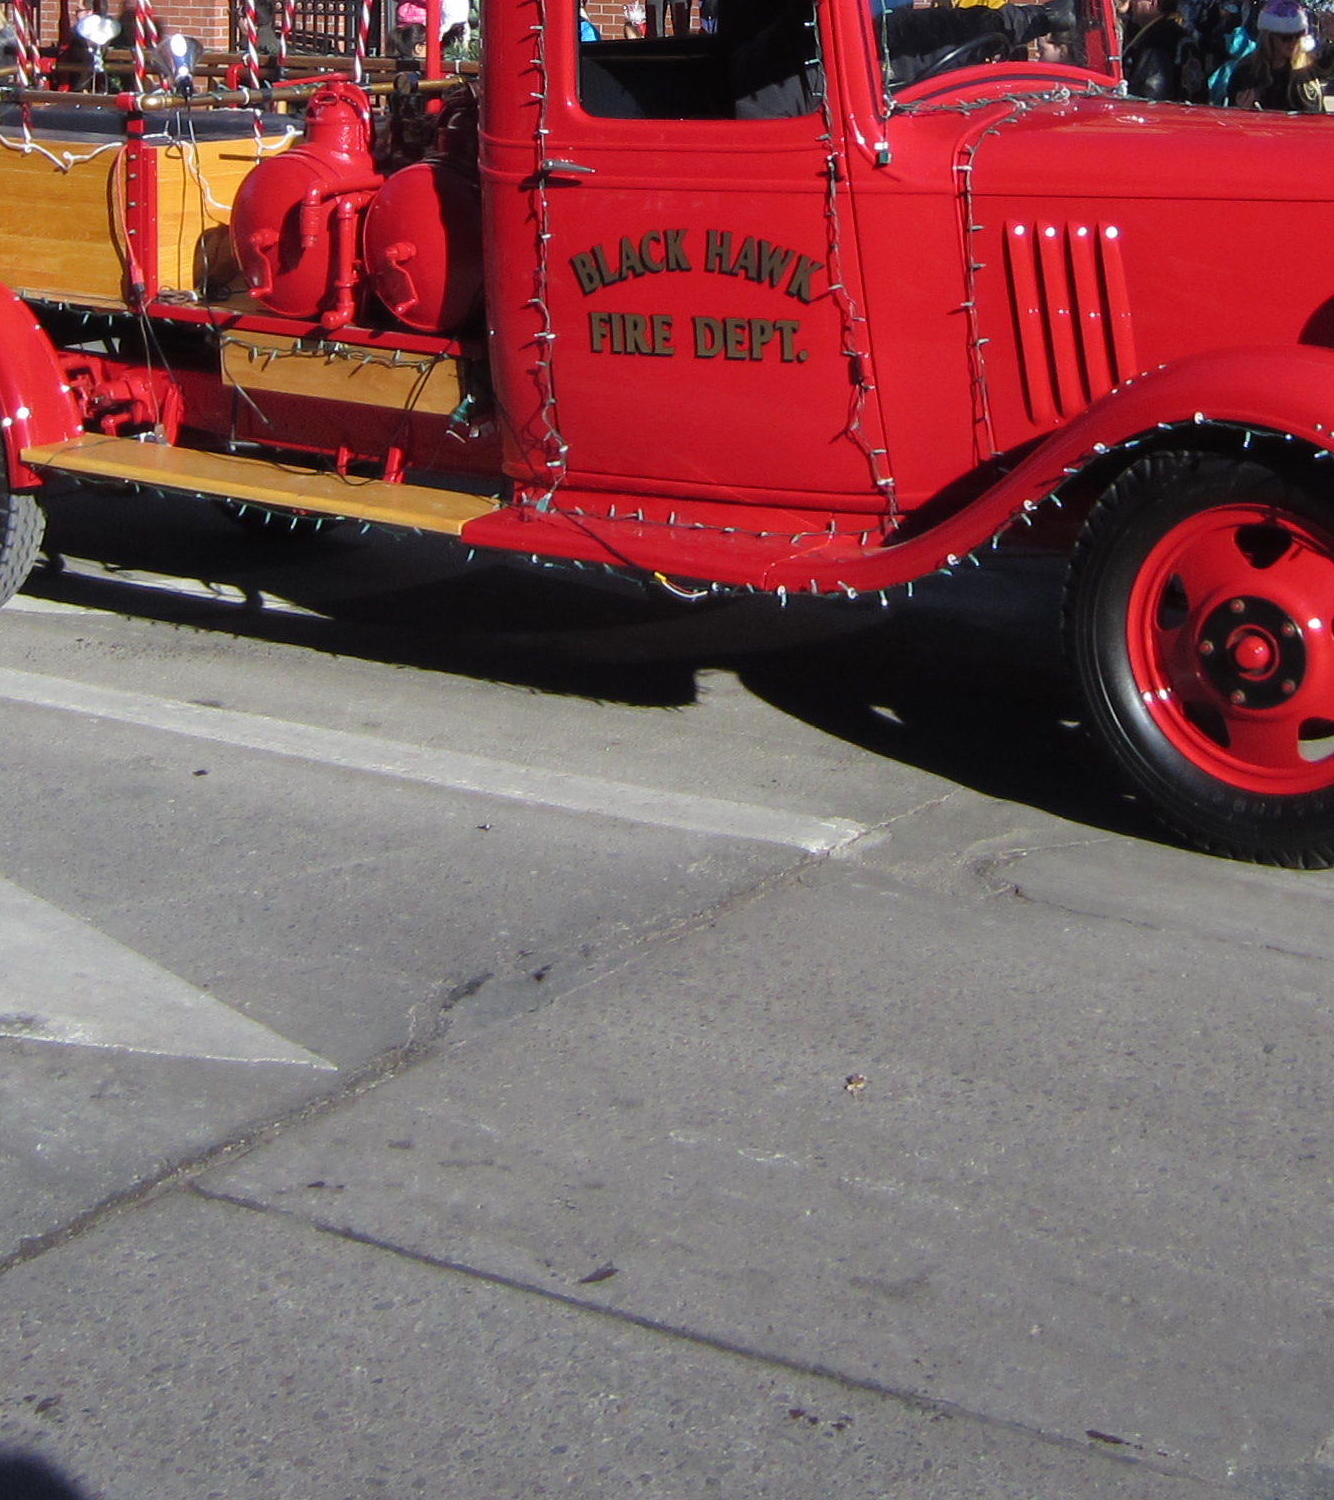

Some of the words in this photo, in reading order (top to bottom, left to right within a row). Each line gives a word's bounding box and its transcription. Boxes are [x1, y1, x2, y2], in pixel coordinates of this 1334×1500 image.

[569, 229, 692, 296] BLACK
[705, 229, 825, 304] HAWK
[589, 312, 674, 356] FIRE
[692, 317, 809, 363] DEPT.
